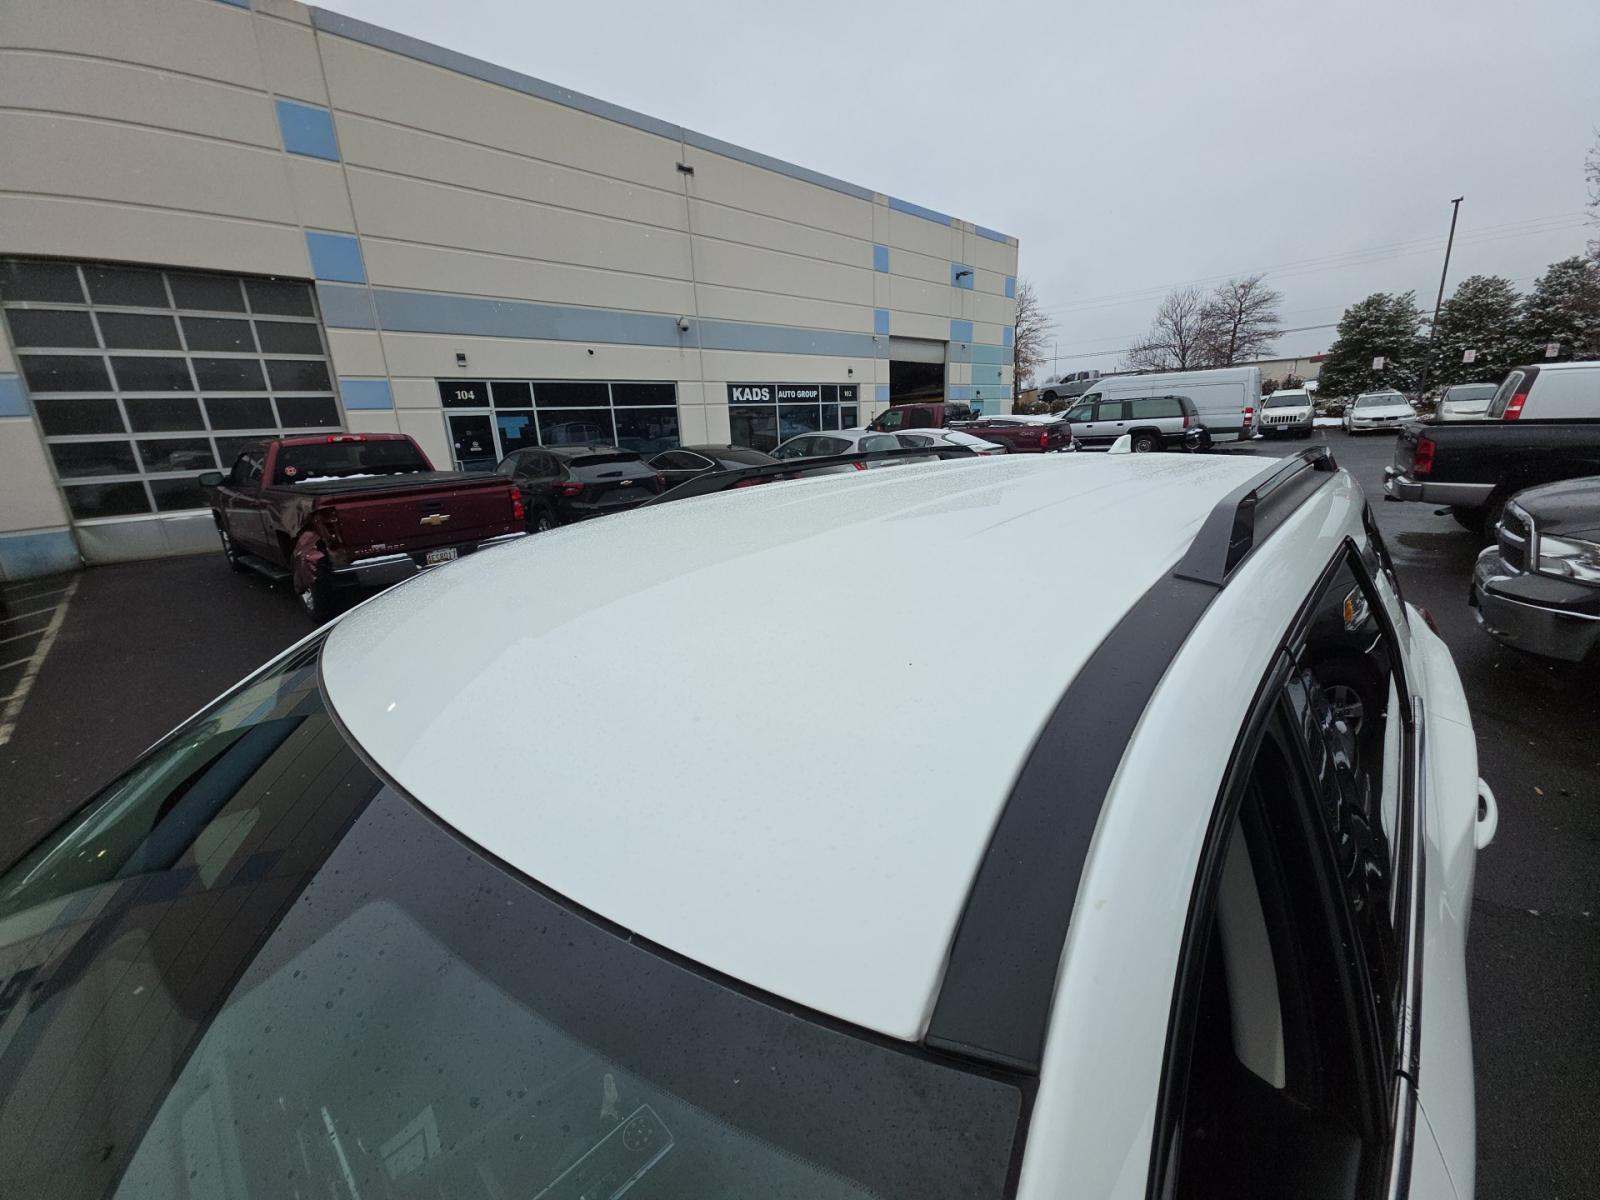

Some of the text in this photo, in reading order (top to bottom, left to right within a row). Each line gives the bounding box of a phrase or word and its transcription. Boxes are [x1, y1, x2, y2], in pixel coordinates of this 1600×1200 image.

[455, 390, 475, 400] 104
[732, 387, 818, 401] KADS AUTO GROUP
